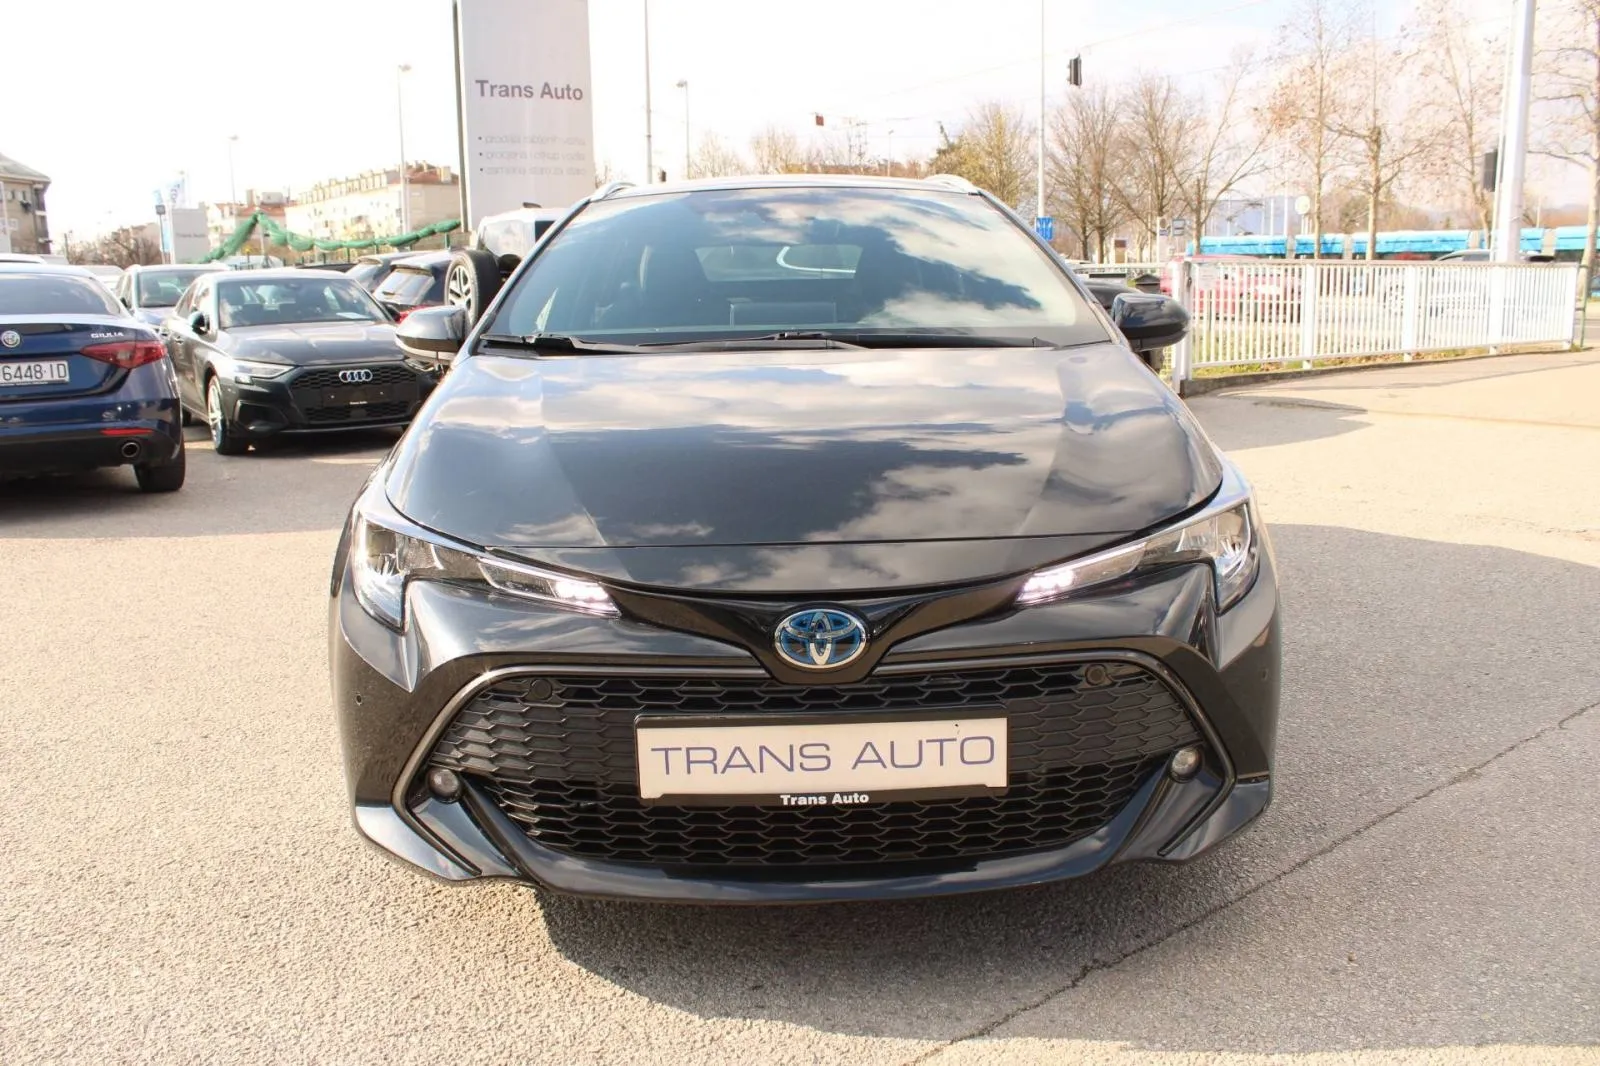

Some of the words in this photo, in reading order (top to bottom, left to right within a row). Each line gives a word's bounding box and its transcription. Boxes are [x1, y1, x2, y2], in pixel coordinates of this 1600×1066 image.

[475, 79, 534, 98] Trans
[540, 82, 584, 100] Auto
[90, 331, 124, 339] GIULIA
[650, 742, 832, 776] TRANS
[851, 735, 995, 771] AUTO
[779, 793, 827, 806] Trans
[832, 792, 869, 805] Auto
